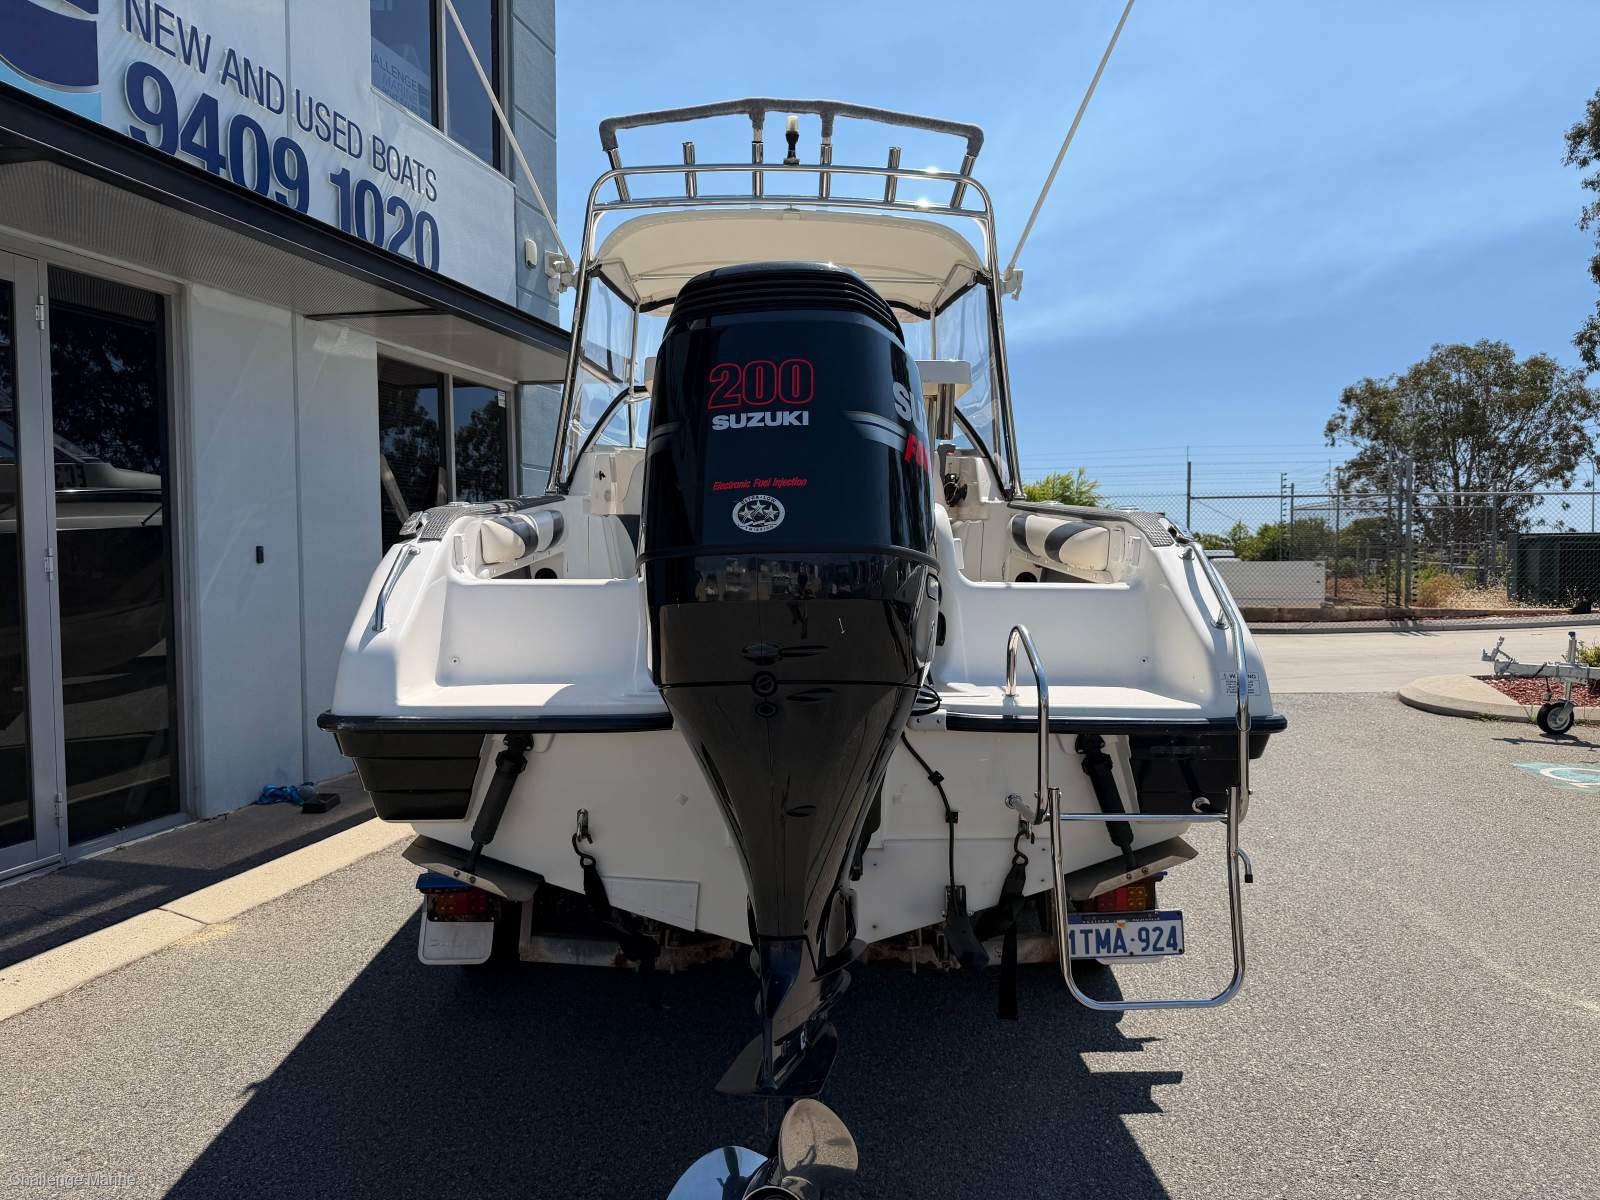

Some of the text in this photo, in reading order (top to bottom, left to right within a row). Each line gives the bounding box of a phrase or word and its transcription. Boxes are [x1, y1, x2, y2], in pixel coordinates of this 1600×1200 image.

[124, 0, 438, 203] NEW AND USED BOATS
[124, 61, 440, 274] 9409 1020
[708, 359, 814, 409] 200
[711, 411, 809, 431] SUZUKI
[713, 477, 808, 490] Electronic Fuel Injection
